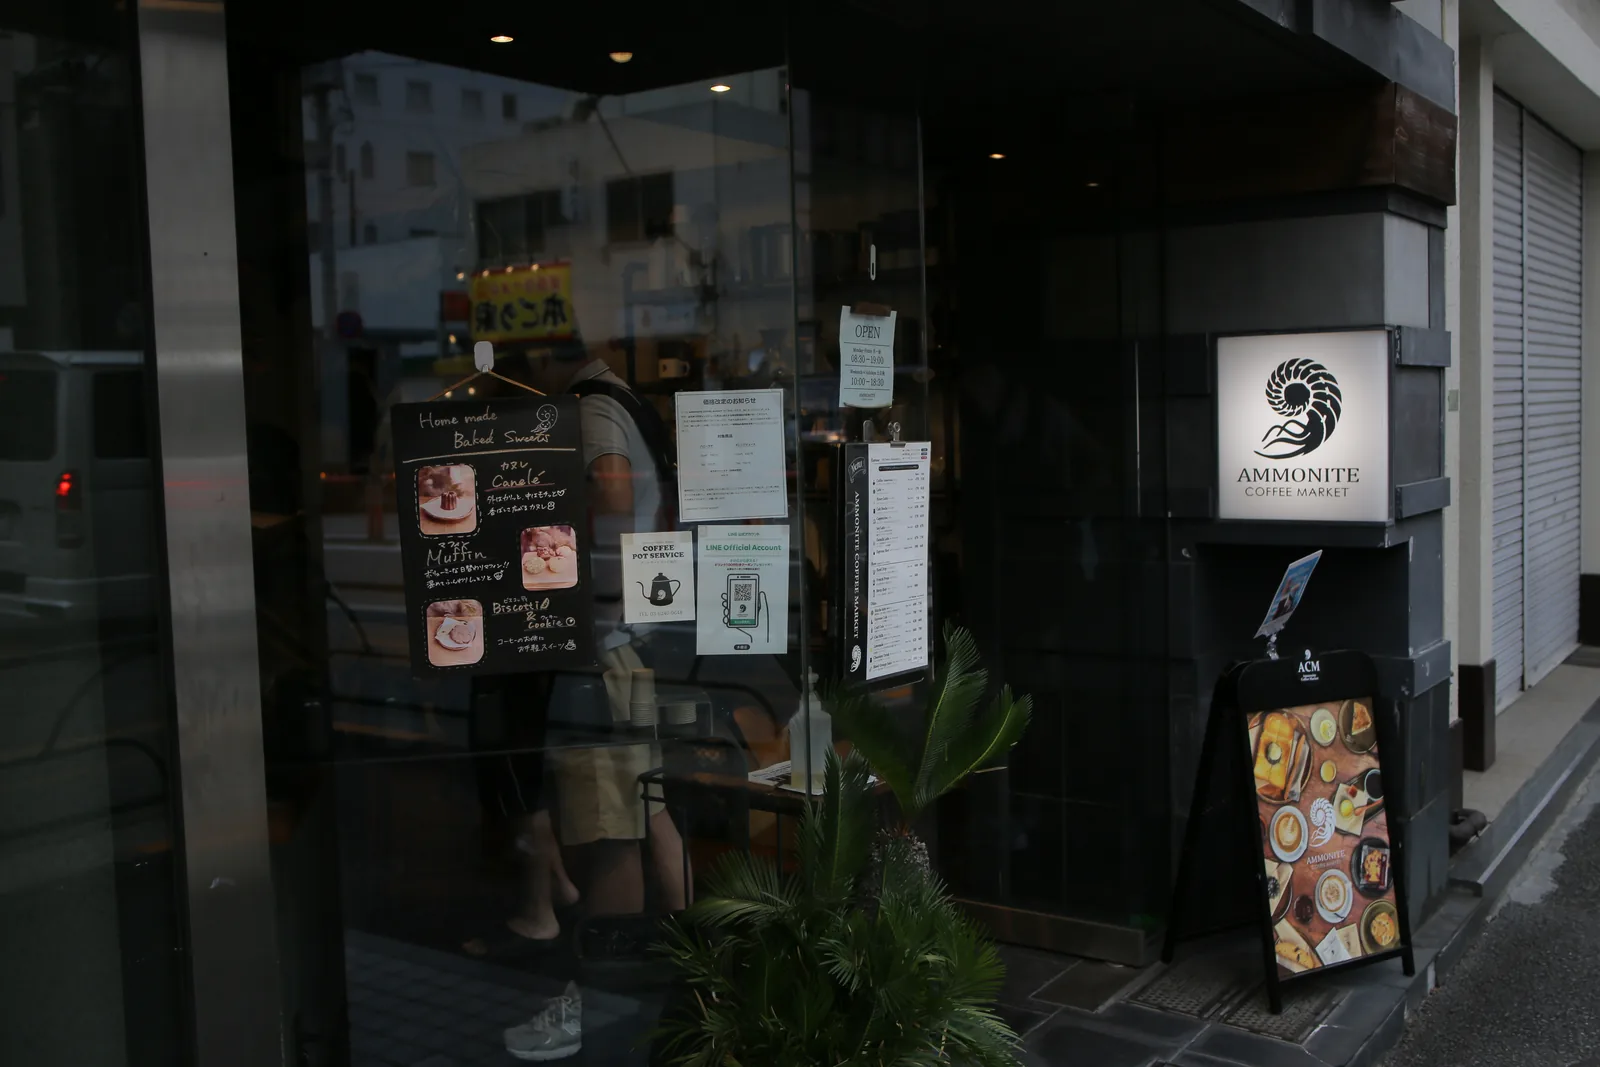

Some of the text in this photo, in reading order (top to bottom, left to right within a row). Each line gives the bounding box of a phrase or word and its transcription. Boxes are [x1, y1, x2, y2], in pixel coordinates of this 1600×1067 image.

[855, 324, 880, 339] OPEN
[419, 406, 498, 428] Home made
[454, 428, 550, 449] Baked Sweets
[501, 461, 528, 470] カヌレ
[492, 468, 545, 488] Canelé
[1237, 468, 1360, 482] AMMONITE
[1245, 486, 1350, 497] COFFEE MARKET
[427, 546, 487, 566] Muffin
[493, 600, 539, 614] Biscotti
[526, 611, 536, 621] &
[1298, 660, 1320, 672] ACM
[1307, 850, 1346, 864] AMMONITE
